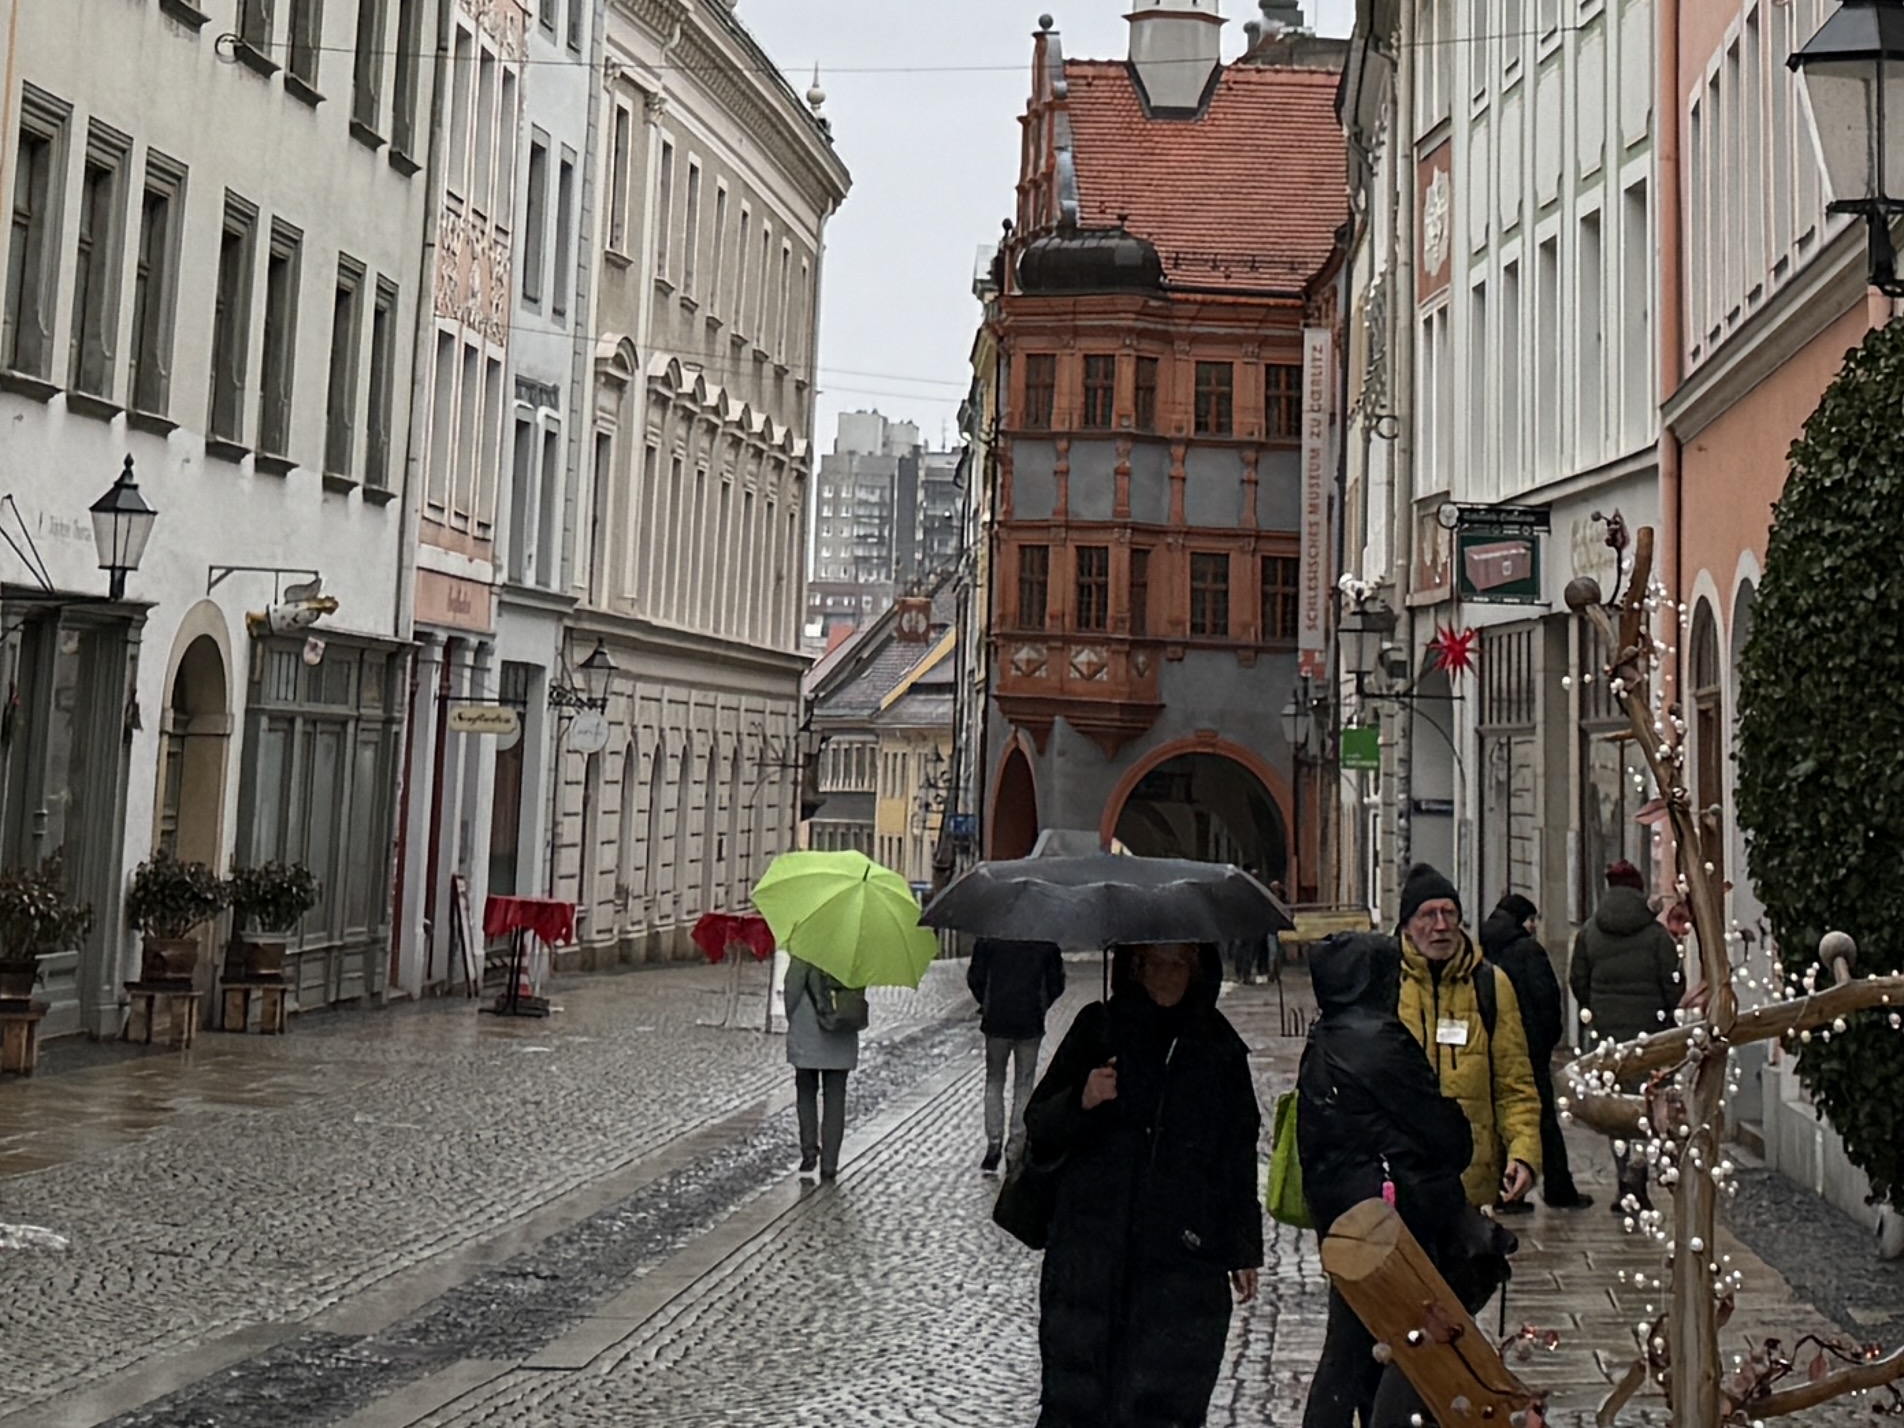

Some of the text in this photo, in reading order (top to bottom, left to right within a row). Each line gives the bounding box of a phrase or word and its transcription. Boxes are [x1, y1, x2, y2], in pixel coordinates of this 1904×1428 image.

[1308, 417, 1324, 441] ZU
[1306, 446, 1323, 517] MUSEUM
[1305, 521, 1322, 632] SCHLESISCHES
